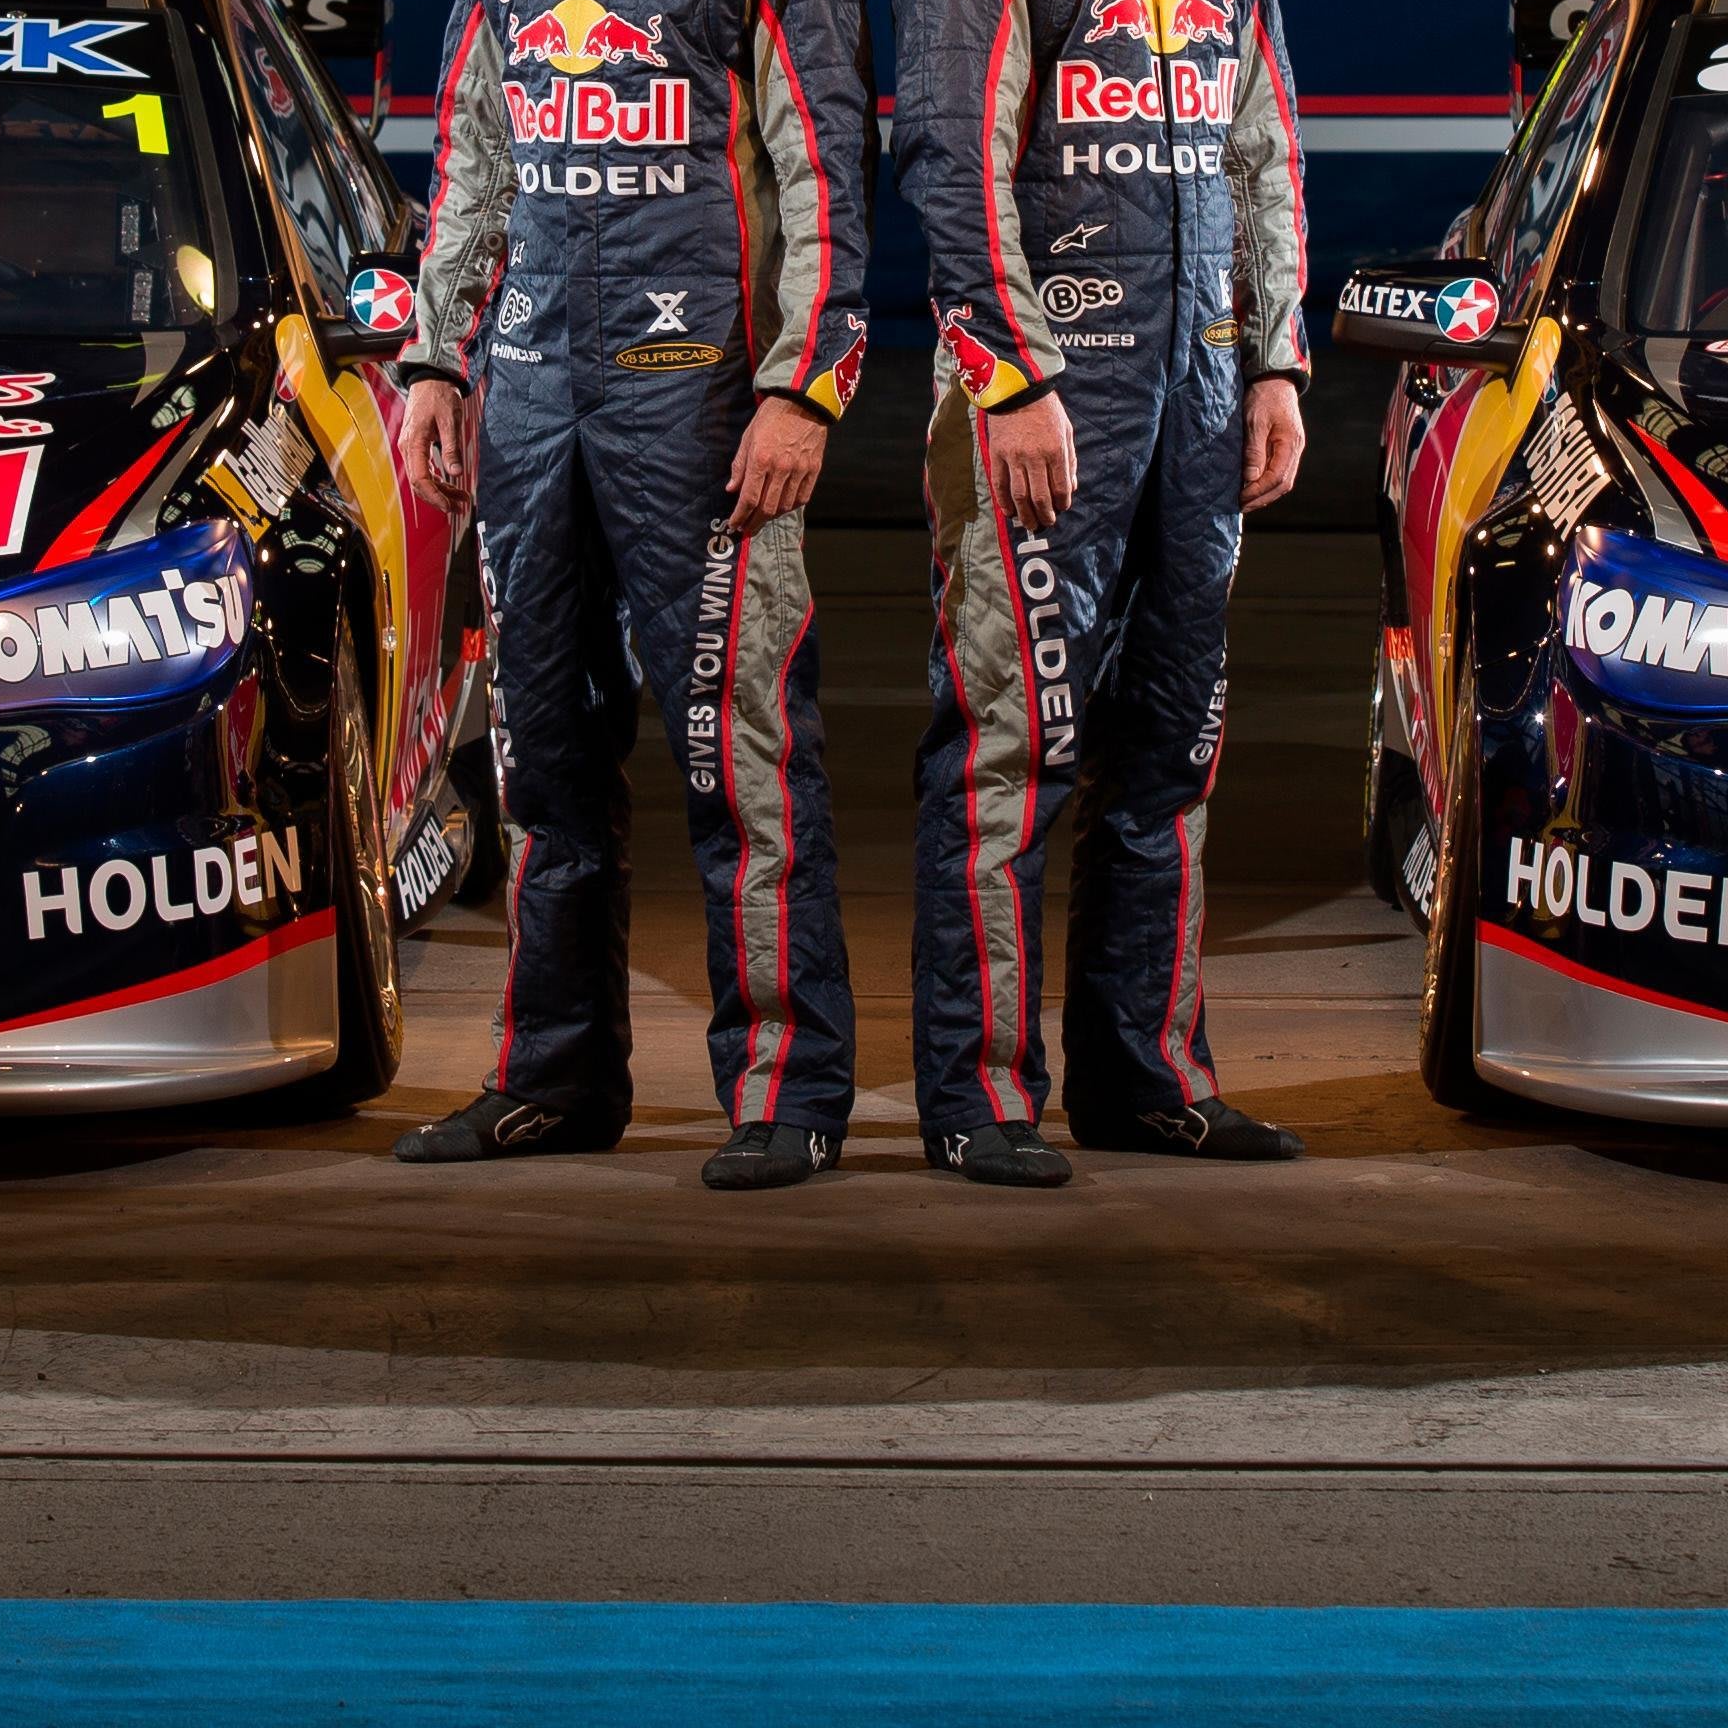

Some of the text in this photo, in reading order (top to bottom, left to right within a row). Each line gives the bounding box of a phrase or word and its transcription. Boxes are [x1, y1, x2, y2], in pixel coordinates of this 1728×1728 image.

[101, 92, 170, 155] 1
[502, 77, 691, 146] Red Bull
[1057, 55, 1240, 125] Red Bull
[1338, 278, 1427, 320] CALTEX
[619, 350, 720, 364] V8 SUPERCARS
[1055, 333, 1135, 348] WNDES
[1523, 391, 1612, 543] TOSHIBA
[688, 517, 735, 794] GIVES YOU WINGS
[1012, 519, 1075, 767] HOLDEN
[1189, 678, 1229, 767] GIVES
[23, 825, 303, 941] HOLDEN
[394, 818, 455, 921] HOLDEN
